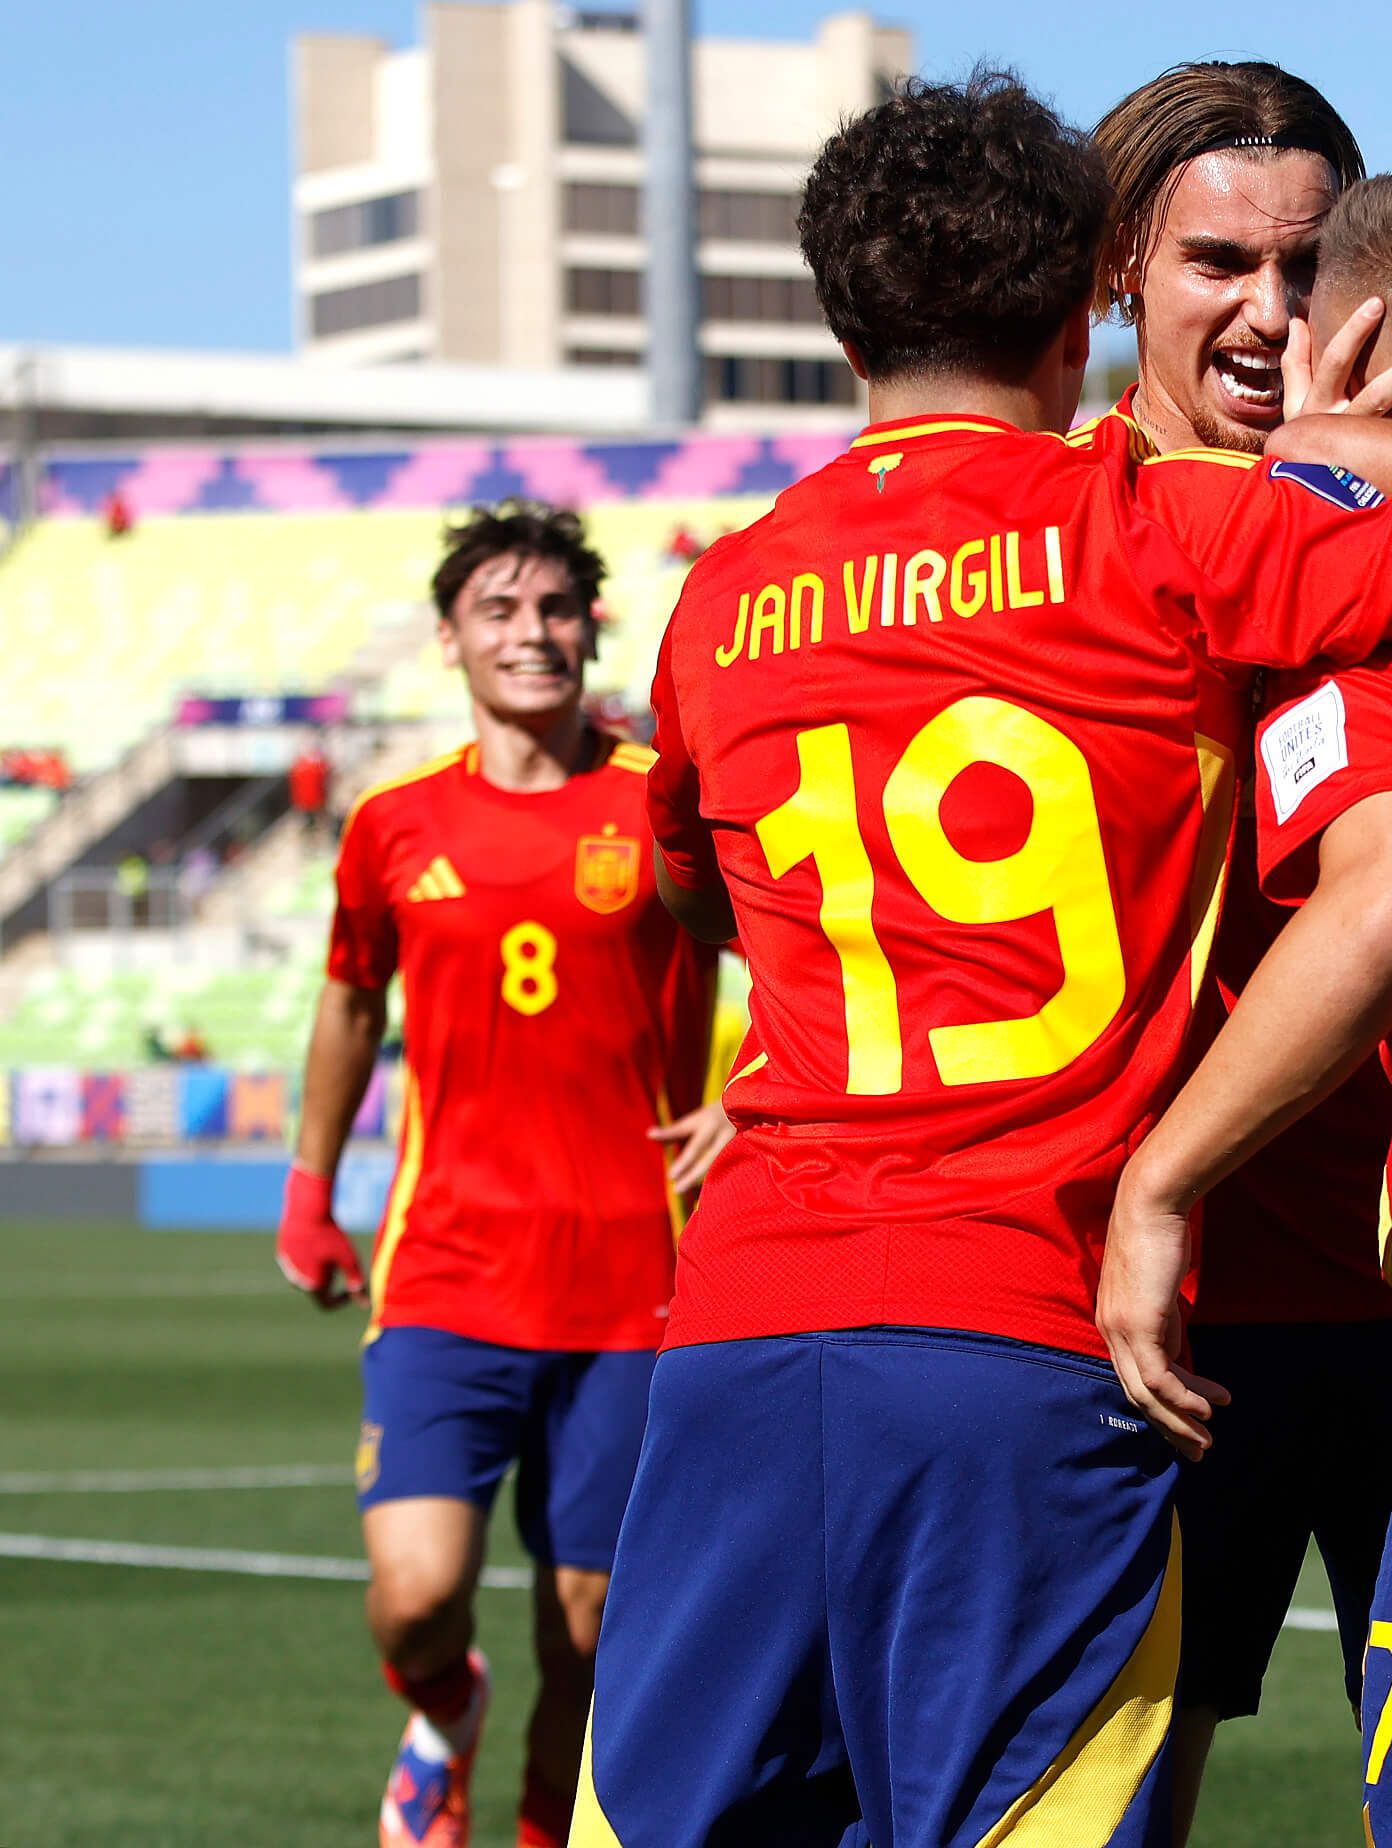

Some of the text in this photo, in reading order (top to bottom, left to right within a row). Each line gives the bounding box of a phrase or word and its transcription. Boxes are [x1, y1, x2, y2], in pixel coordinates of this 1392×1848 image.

[714, 525, 1066, 669] JAN VIRGILI
[754, 695, 1127, 1096] 19
[500, 919, 558, 1017] 8
